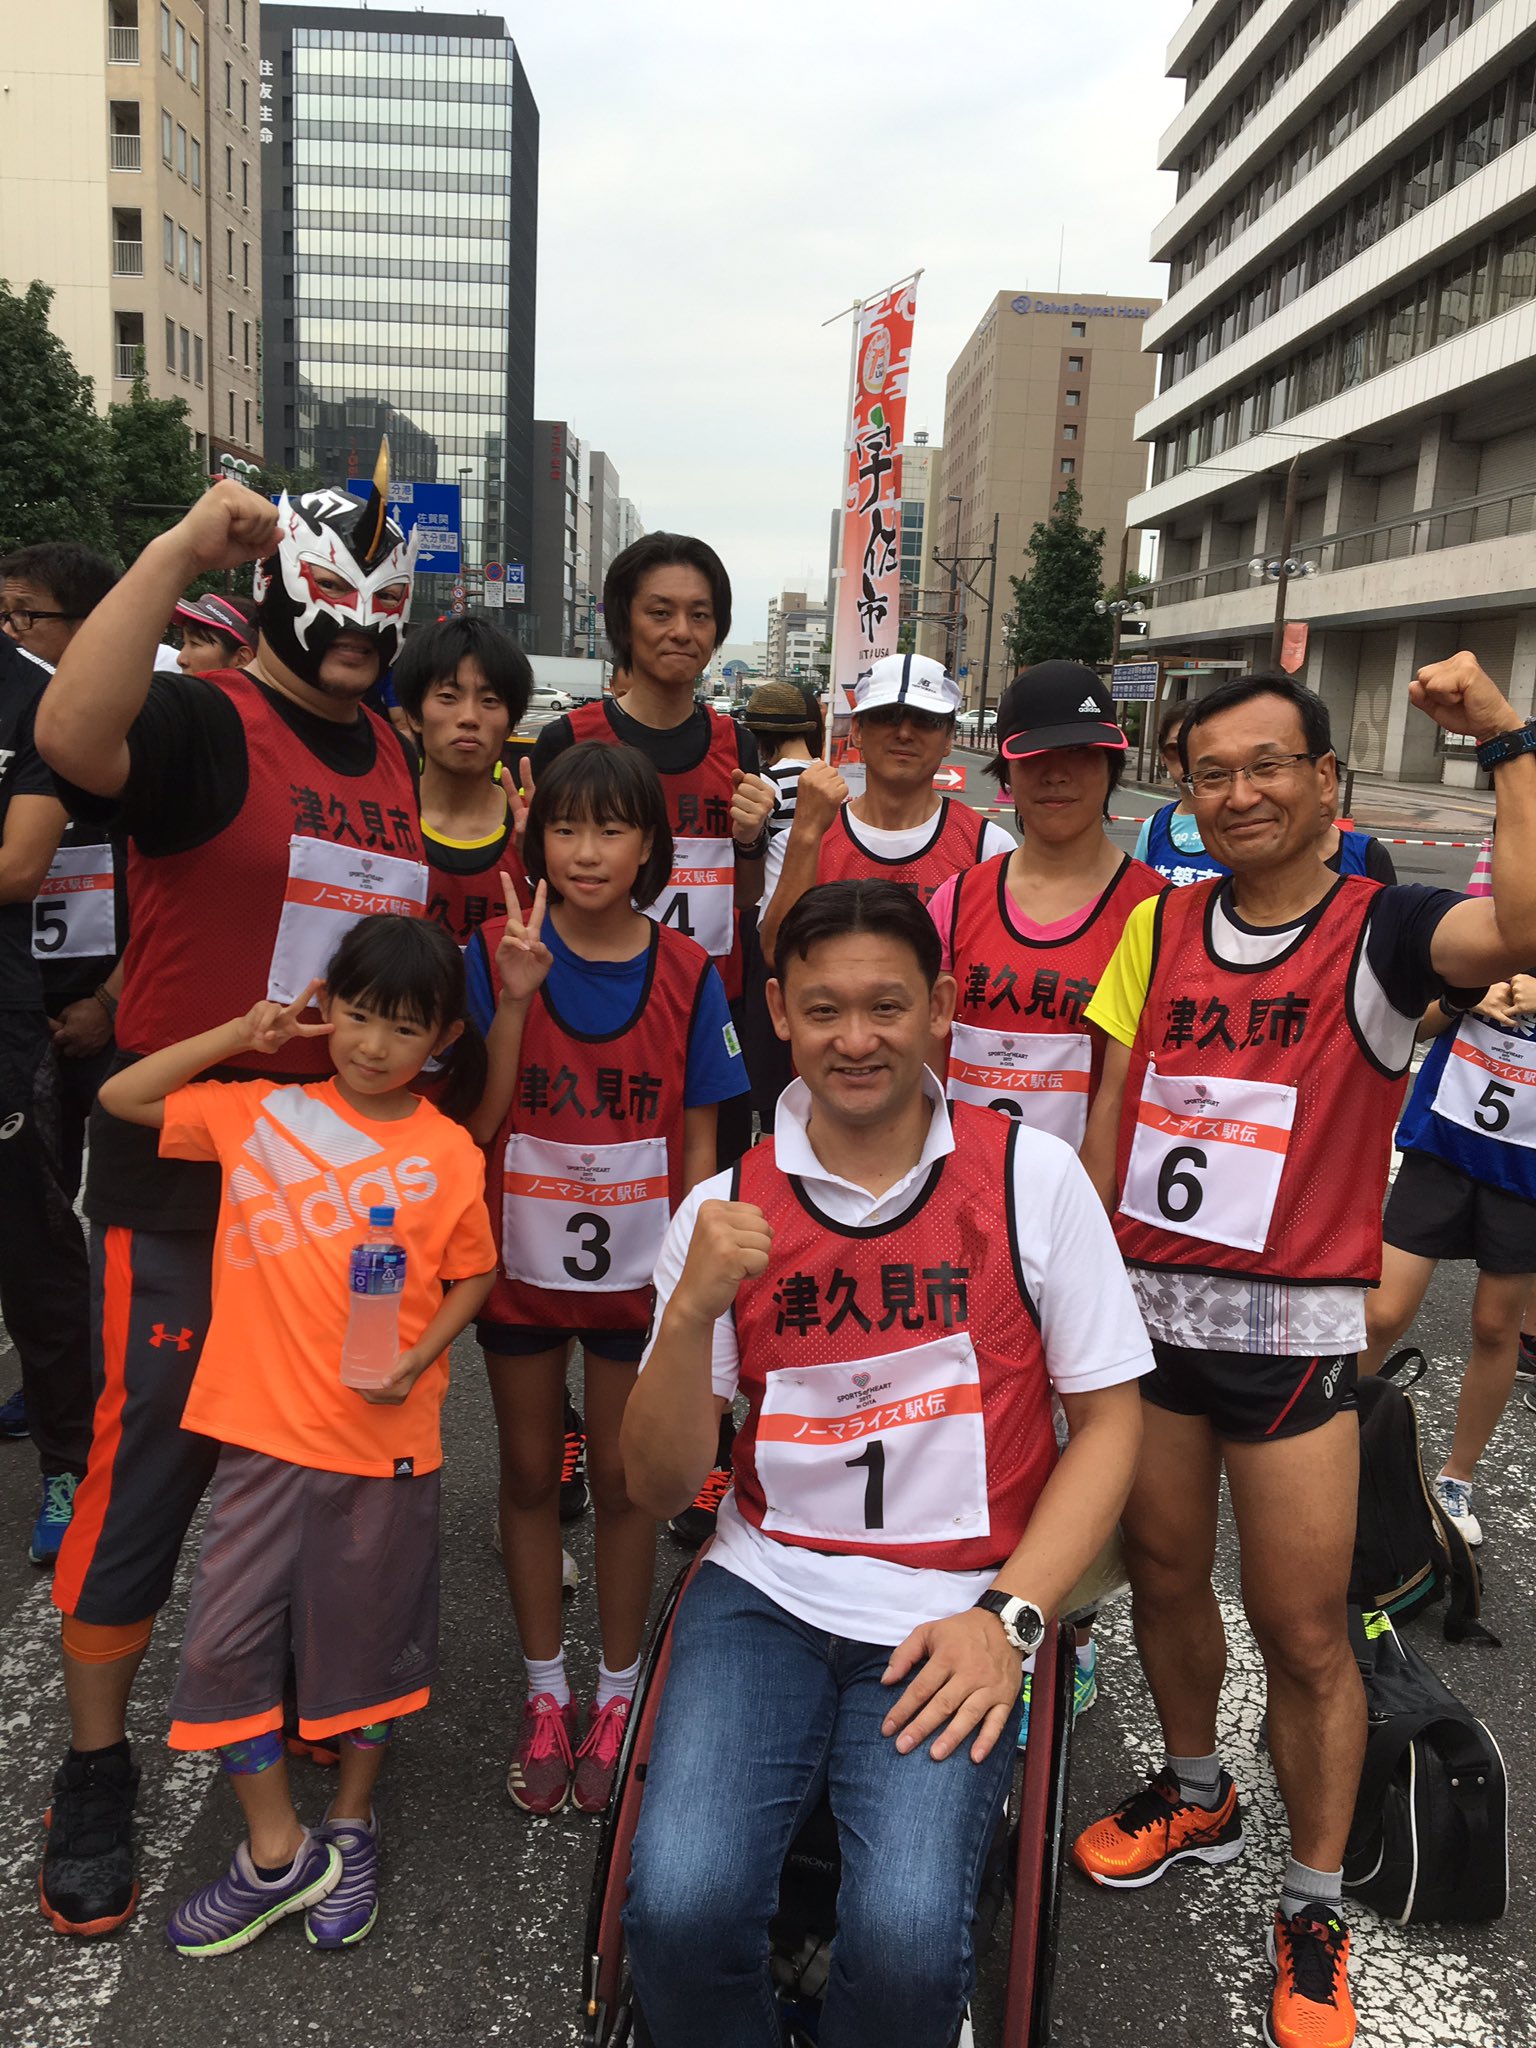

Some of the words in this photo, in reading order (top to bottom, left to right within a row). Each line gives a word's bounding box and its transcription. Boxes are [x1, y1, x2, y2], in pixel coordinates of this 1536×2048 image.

[260, 59, 274, 144] 住友生命
[1034, 300, 1070, 315] Daiwa
[1072, 302, 1115, 319] Roynet
[1117, 305, 1150, 319] Hotel
[289, 784, 418, 854] 津久見市
[34, 900, 68, 953] 5
[660, 892, 695, 936] 4
[963, 962, 1097, 1026] 津久見市
[1162, 991, 1310, 1053] 津久見市
[520, 1063, 662, 1124] 津久見市
[960, 1066, 1063, 1089] ノーマライズ駅伝
[1474, 1079, 1516, 1132] 5
[224, 1155, 438, 1271] addas
[527, 1179, 647, 1202] ノーマライズ駅伝
[1156, 1146, 1207, 1222] 6
[562, 1212, 611, 1282] 3
[772, 1261, 971, 1337] 津久見市
[793, 1393, 946, 1440] ノーマライズ駅伝
[859, 1394, 872, 1403] 2017
[862, 1399, 877, 1407] OITA
[845, 1440, 886, 1530] 1
